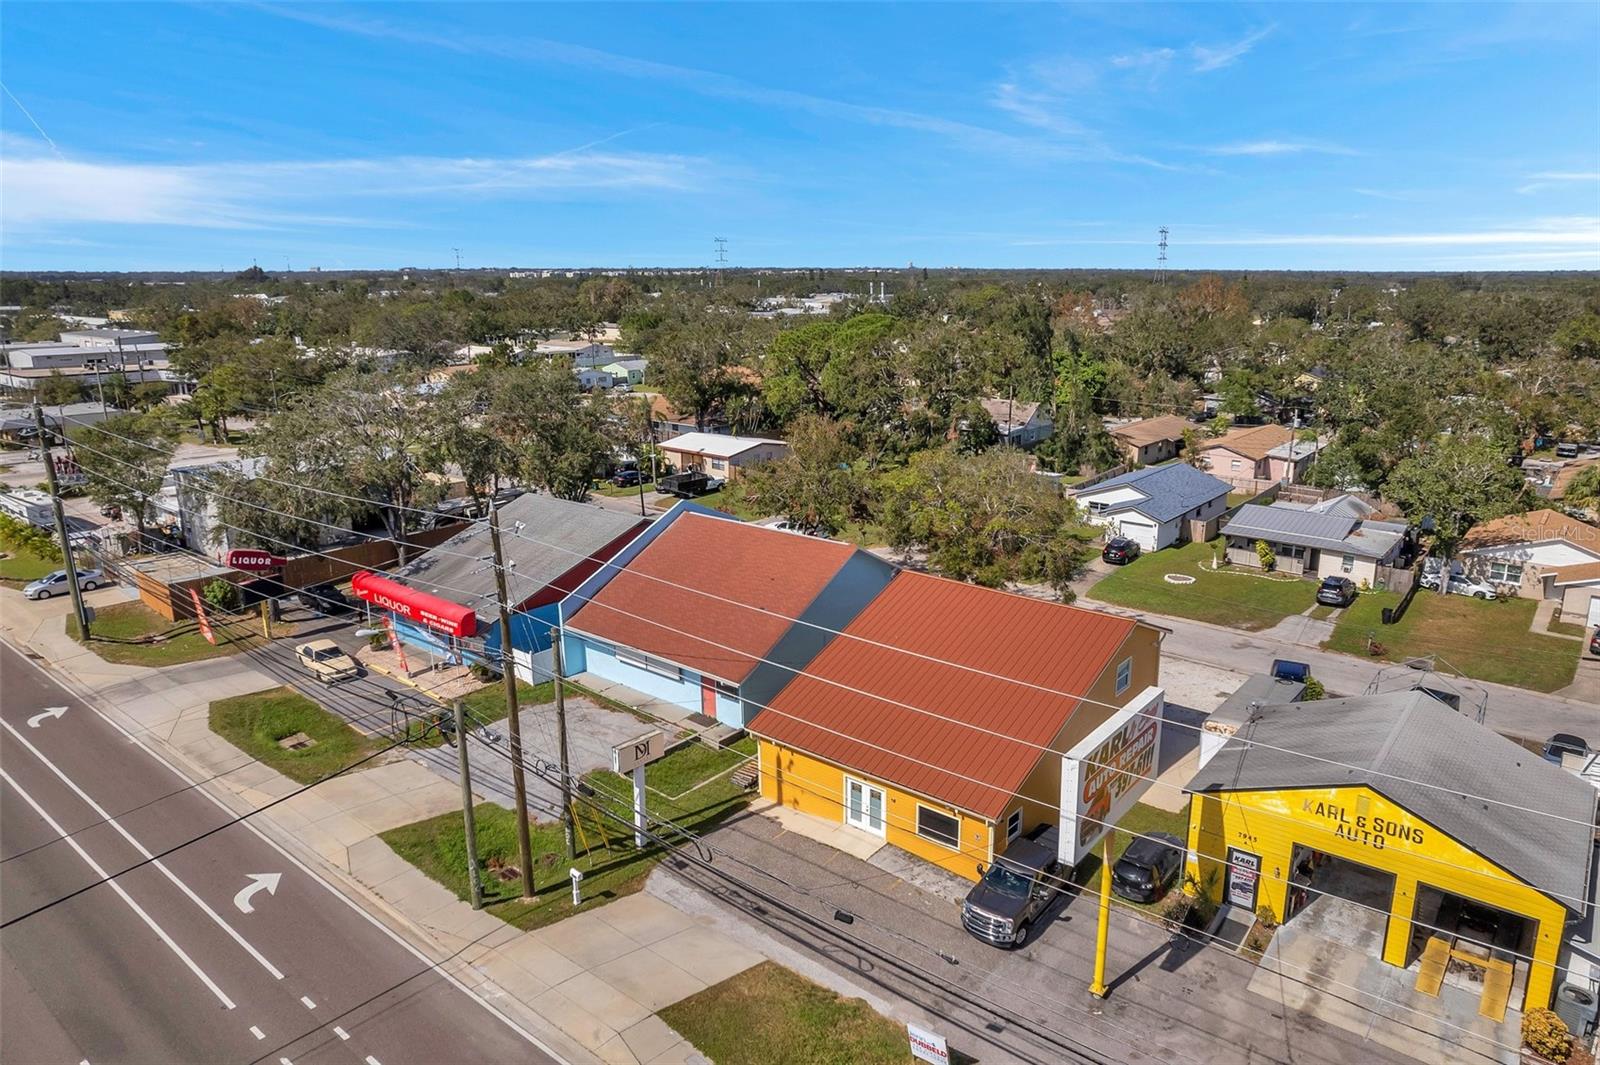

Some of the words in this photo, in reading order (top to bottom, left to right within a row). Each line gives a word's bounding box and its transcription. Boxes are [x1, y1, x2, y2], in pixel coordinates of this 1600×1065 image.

[232, 556, 272, 565] LIQUOR
[374, 593, 412, 615] LIQUOR
[420, 610, 438, 621] BEER
[429, 620, 454, 634] CIGARS
[1085, 725, 1129, 780] KARL
[1088, 761, 1117, 796] AUTO
[1120, 729, 1153, 766] REPAIR
[1303, 799, 1350, 824] KARL
[1356, 815, 1366, 828] &
[1373, 817, 1424, 844] SONS
[1335, 824, 1385, 850] AUTO
[1234, 855, 1255, 866] KARL
